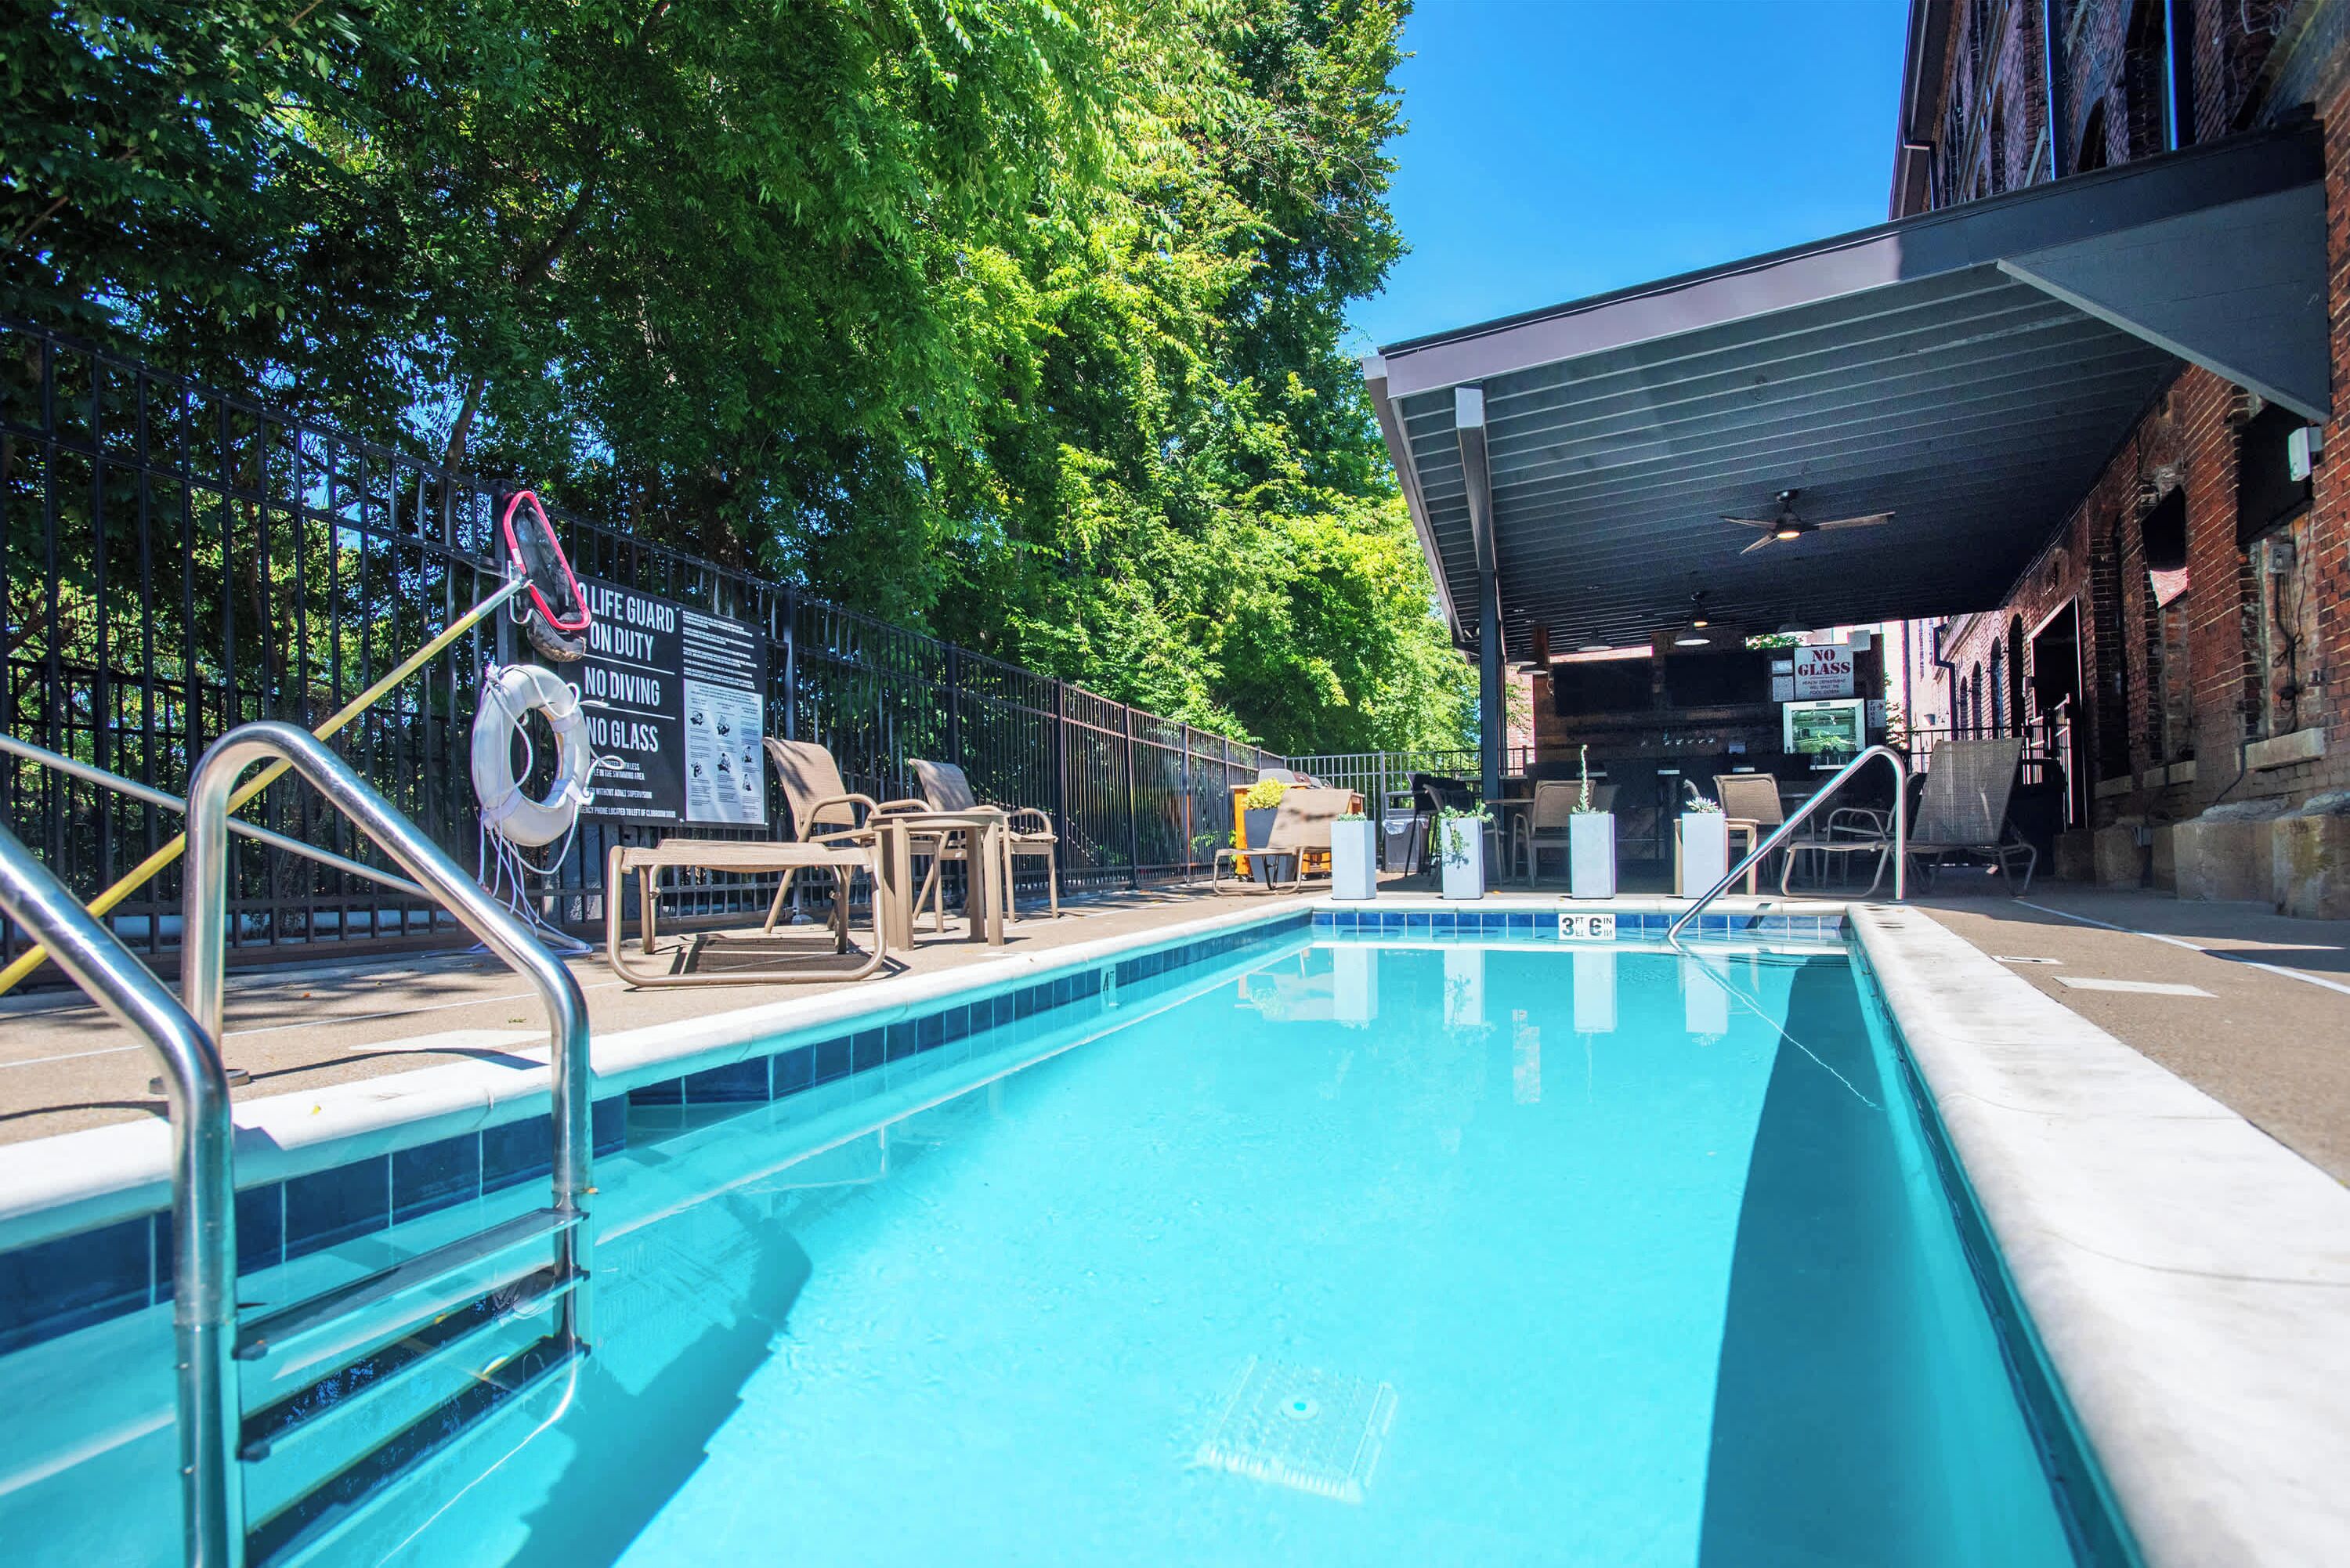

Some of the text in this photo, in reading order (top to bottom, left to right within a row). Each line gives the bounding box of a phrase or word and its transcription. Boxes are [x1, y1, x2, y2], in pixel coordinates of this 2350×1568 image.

[578, 582, 588, 607] O
[591, 586, 624, 620] LIFE
[627, 596, 675, 634] GUARD
[590, 621, 612, 652] ON
[615, 628, 654, 662] DUTY
[1813, 649, 1835, 662] NO
[584, 667, 606, 697] NO
[609, 671, 660, 706] DIVING
[1798, 662, 1850, 676] GLASS
[585, 716, 607, 746] NO
[611, 719, 659, 753] GLASS
[1562, 917, 1574, 936] 3
